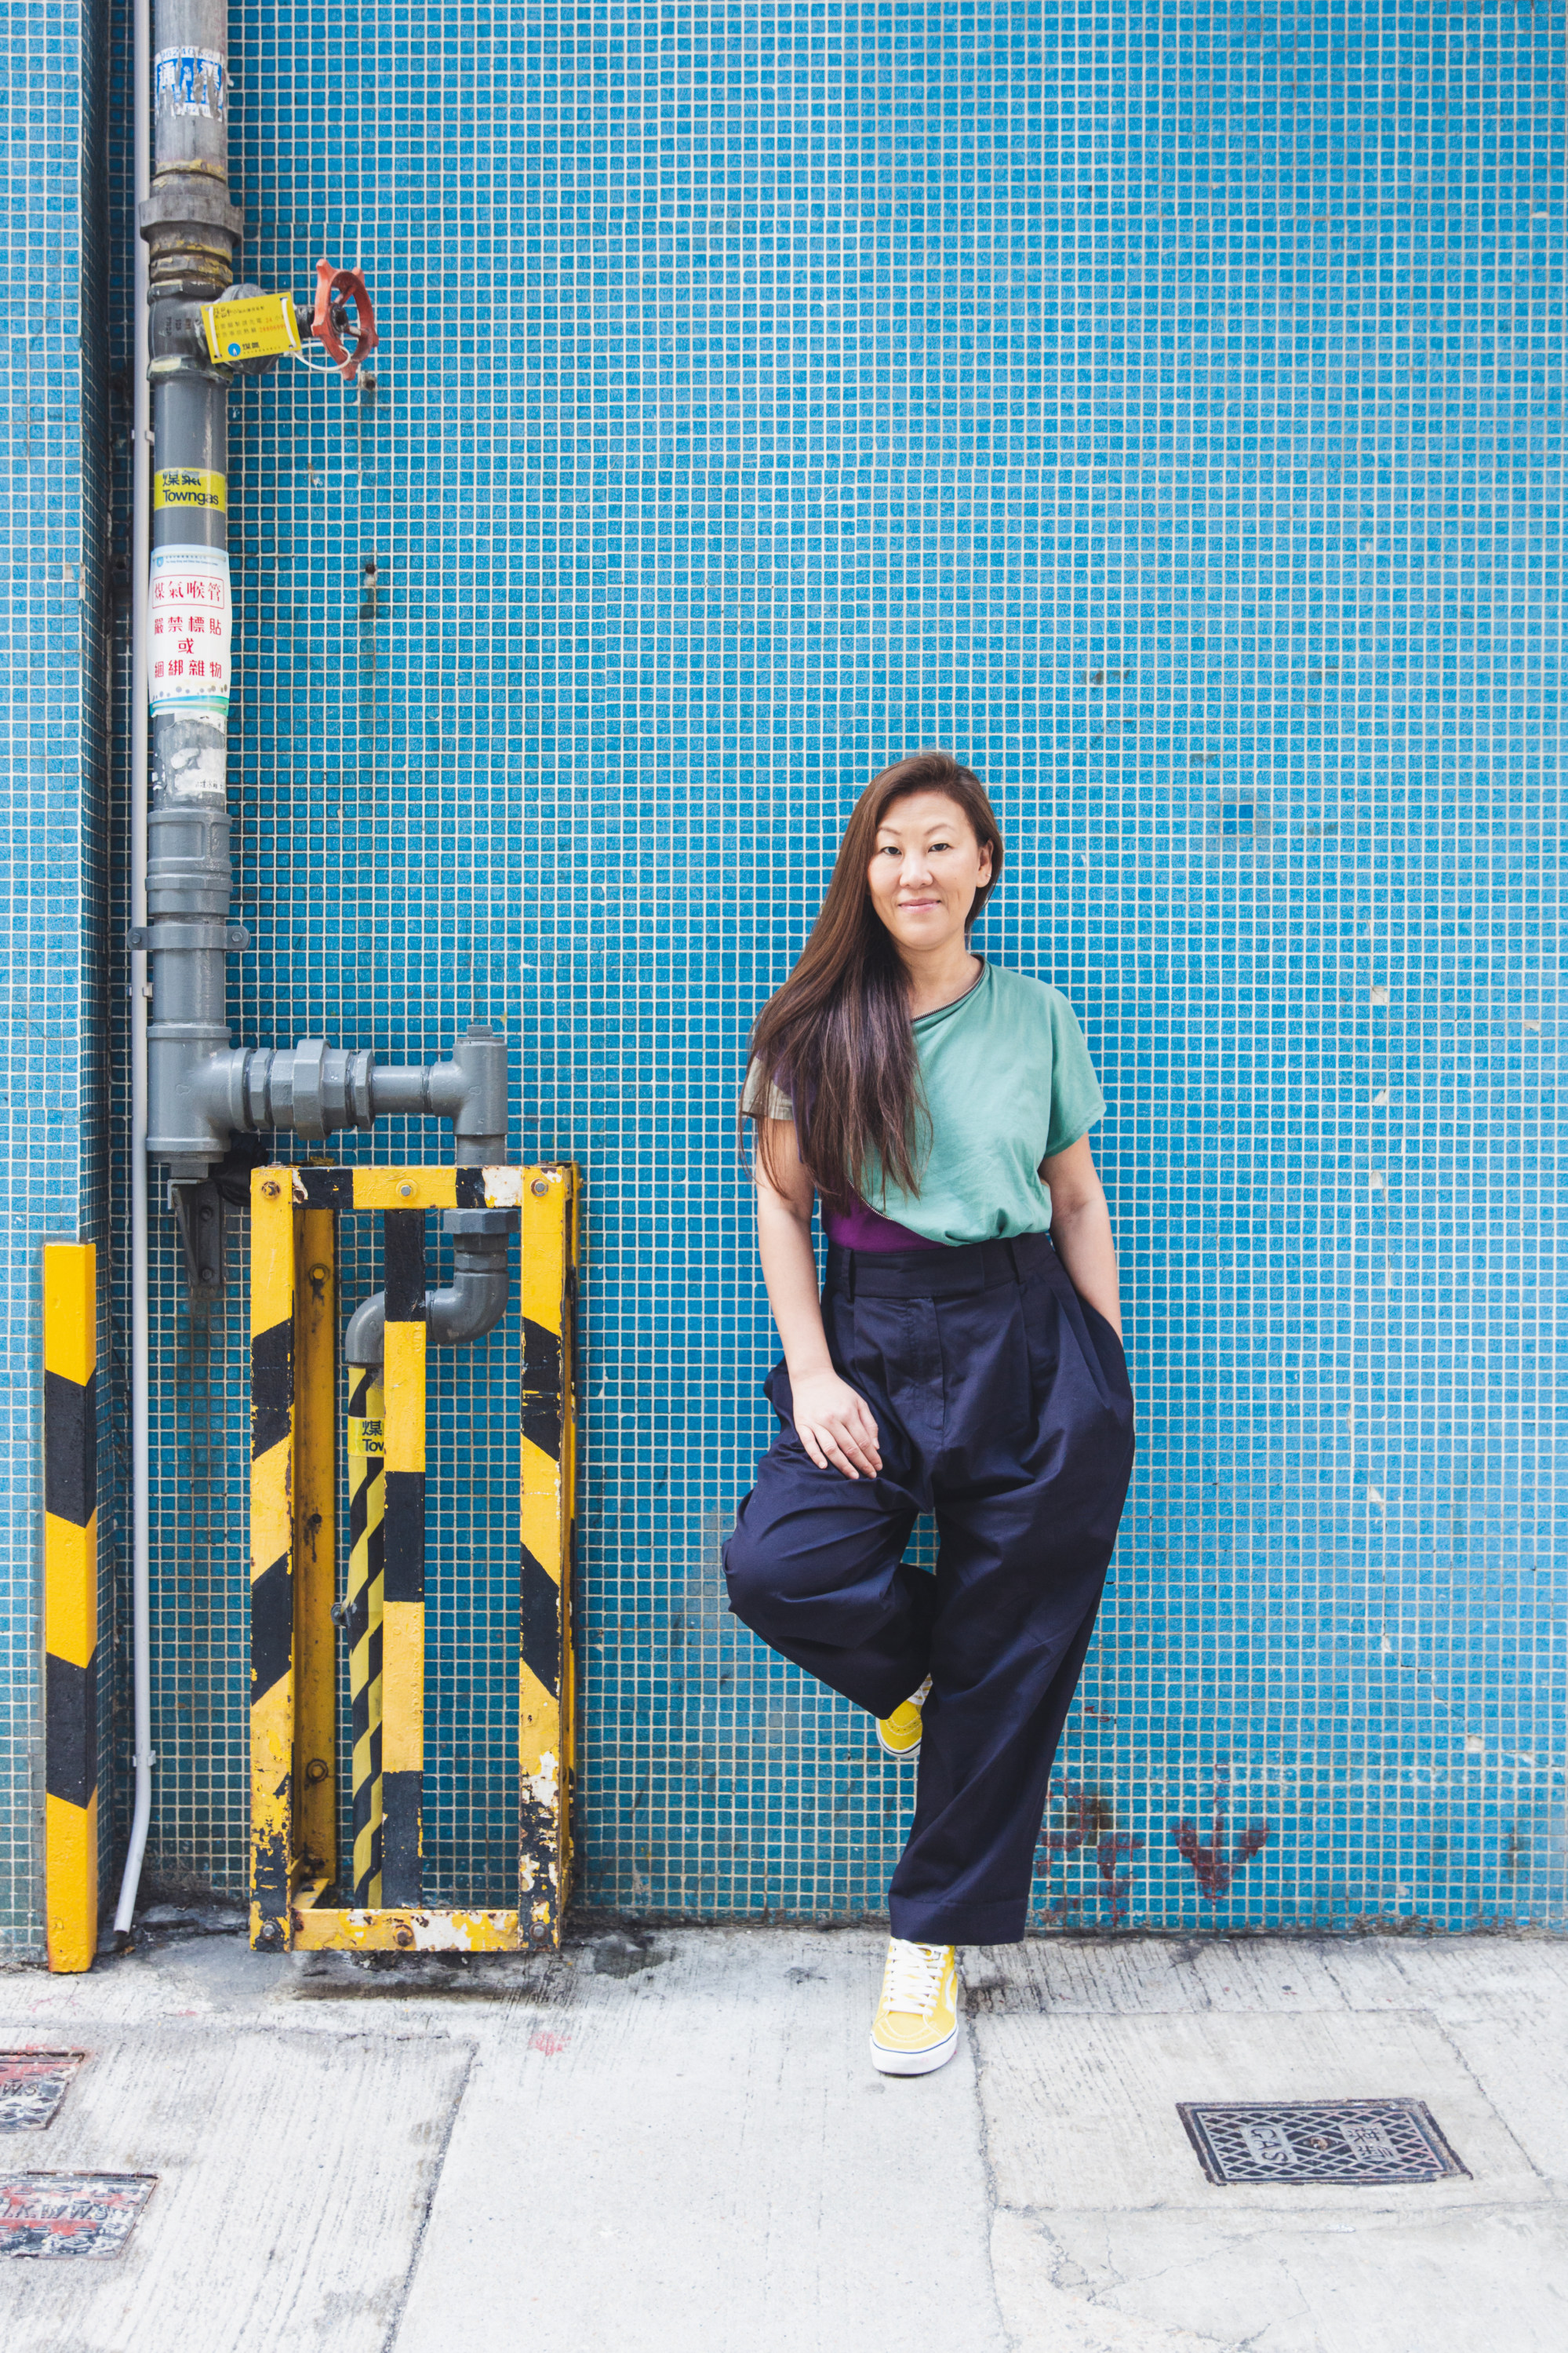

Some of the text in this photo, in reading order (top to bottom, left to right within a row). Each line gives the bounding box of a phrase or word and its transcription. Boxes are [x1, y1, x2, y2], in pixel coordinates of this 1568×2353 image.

[163, 490, 219, 505] Towngas
[155, 581, 221, 602] 煤氣喉管
[154, 616, 221, 636] 嚴禁標貼
[178, 638, 194, 654] 或
[155, 659, 222, 679] 綑綁雜物
[362, 1420, 383, 1437] 煤
[1251, 2128, 1289, 2162] GAS
